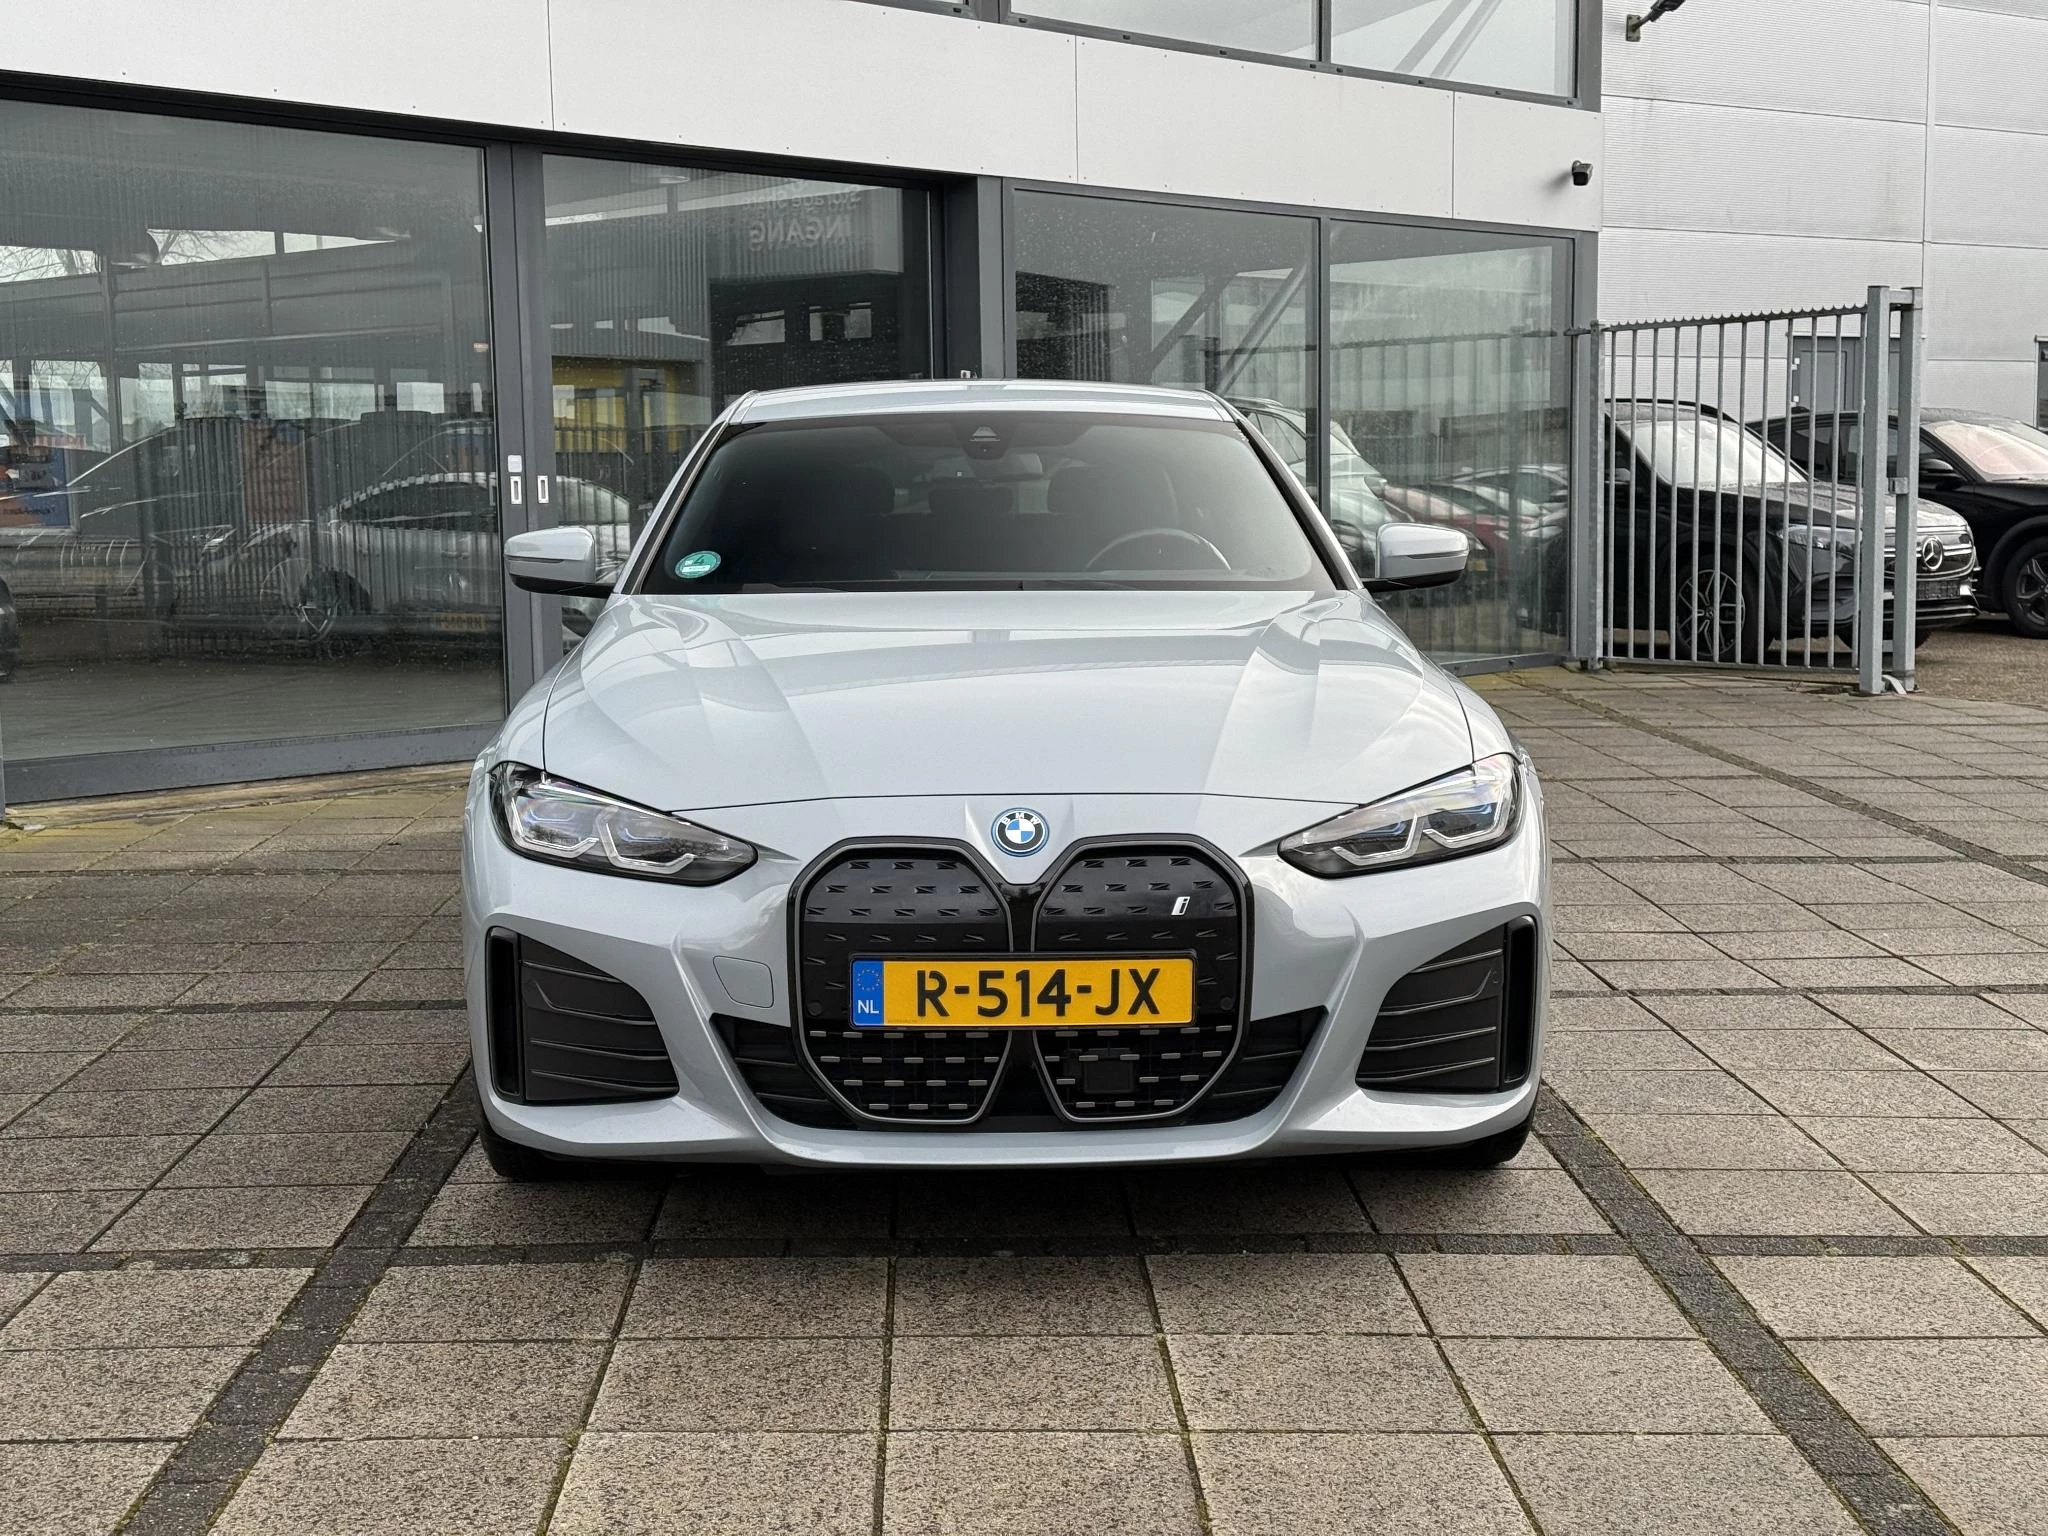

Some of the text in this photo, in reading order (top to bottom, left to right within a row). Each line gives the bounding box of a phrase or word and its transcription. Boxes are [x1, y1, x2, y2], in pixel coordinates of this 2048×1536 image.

[1001, 812, 1041, 825] BMW
[916, 968, 1161, 1018] R-514-JX
[857, 999, 880, 1014] NL
